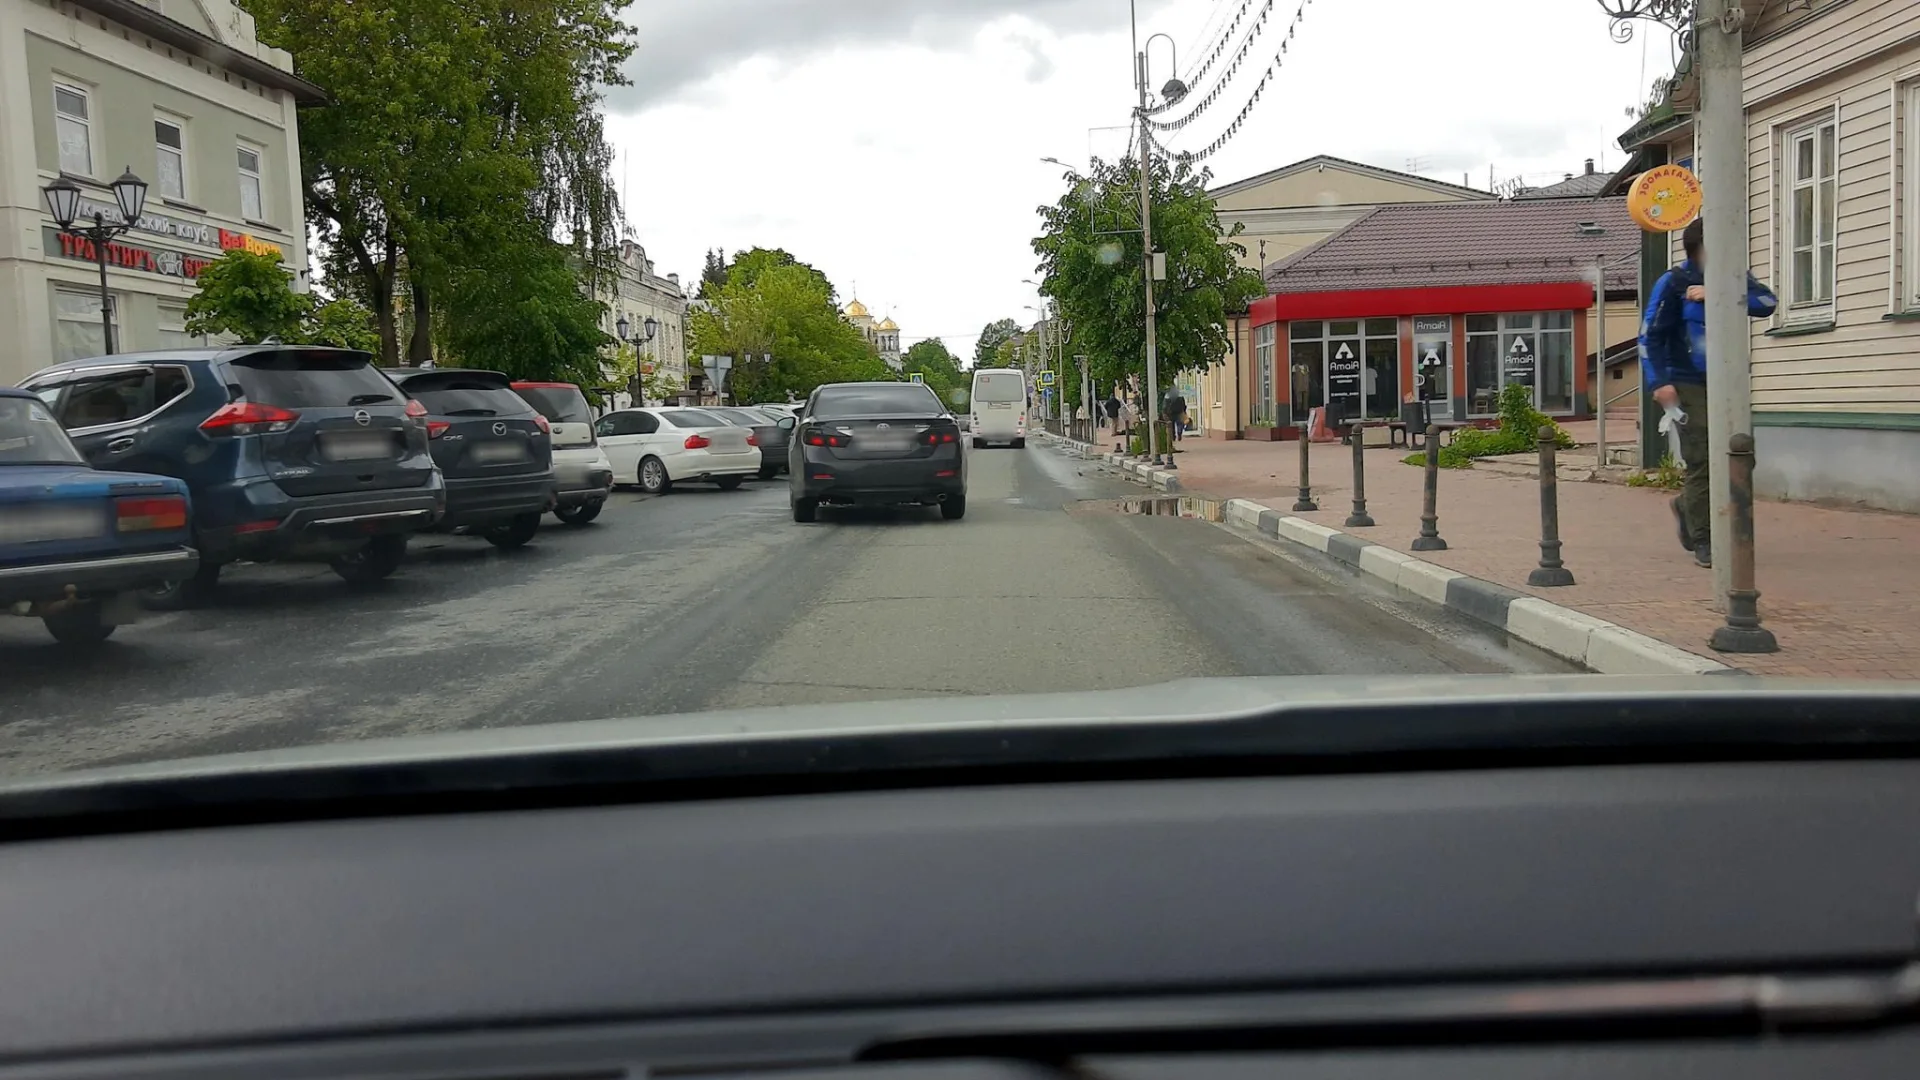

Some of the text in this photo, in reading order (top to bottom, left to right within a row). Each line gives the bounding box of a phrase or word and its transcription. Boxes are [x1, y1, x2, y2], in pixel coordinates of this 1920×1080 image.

[1640, 168, 1698, 195] ЗООМАГАЗИН
[178, 223, 209, 244] клуб
[57, 231, 156, 273] ТРАТИРЪ
